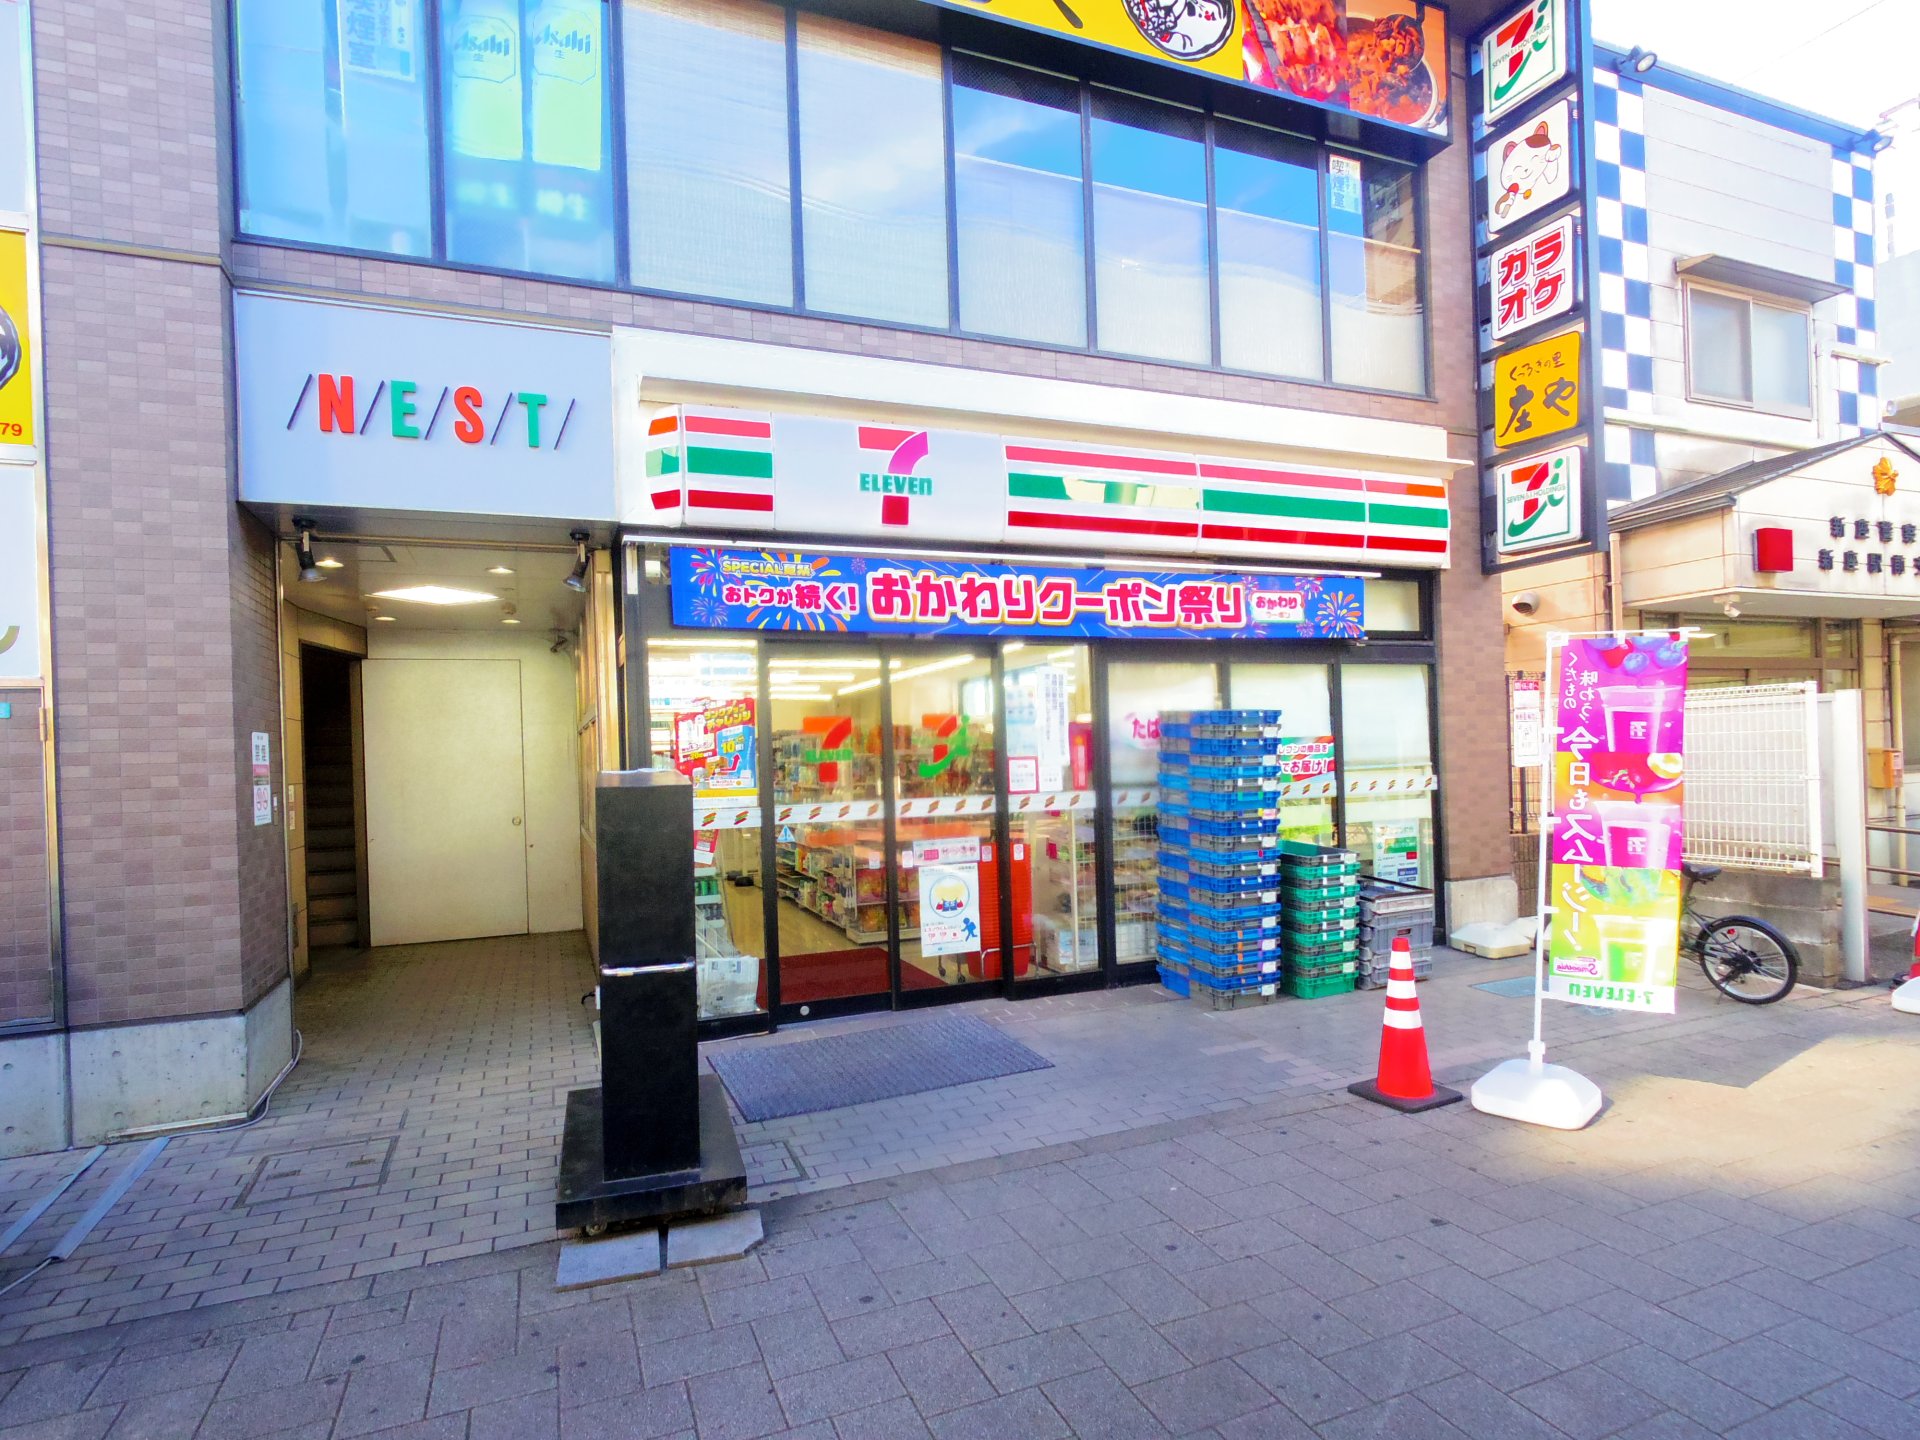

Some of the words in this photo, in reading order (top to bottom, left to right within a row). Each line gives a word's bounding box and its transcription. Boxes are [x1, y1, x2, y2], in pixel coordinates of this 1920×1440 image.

[454, 30, 510, 57] Asahi
[535, 24, 591, 55] Asahi
[1498, 376, 1577, 438] 庄や
[870, 572, 1242, 625] おかわりクーポン祭り
[1256, 595, 1298, 610] おかわり
[1277, 759, 1327, 773] でお届け!
